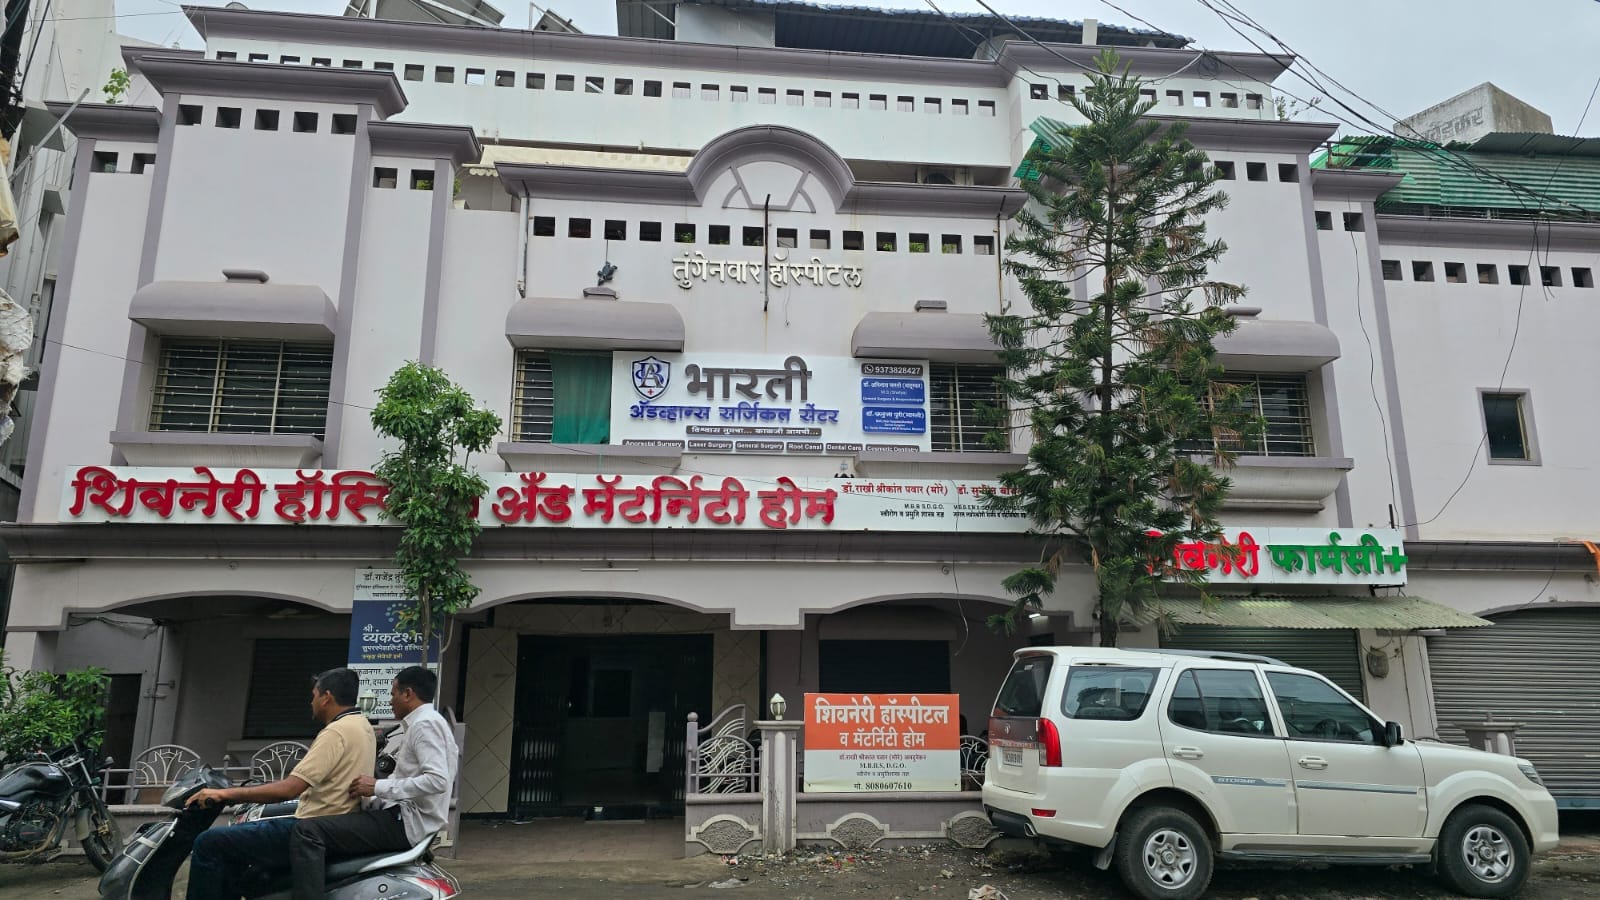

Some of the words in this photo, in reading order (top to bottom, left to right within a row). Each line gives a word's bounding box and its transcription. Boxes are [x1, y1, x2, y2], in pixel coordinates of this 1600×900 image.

[672, 250, 762, 290] तुंगेनवार
[768, 251, 864, 288] हॉस्पीटल
[685, 356, 812, 401] भारती
[876, 366, 921, 375] 9373828427
[719, 401, 791, 423] सर्जिकल
[799, 403, 839, 424] सेंटर
[69, 466, 267, 522] शिवनेरी
[274, 469, 479, 523] हॉस्पि
[581, 474, 750, 525] मॅटर्निटी
[757, 477, 838, 529] होम
[876, 482, 902, 494] श्रीकांत
[904, 486, 924, 494] पवार
[926, 483, 949, 496] (मोरे)
[956, 484, 969, 495] डॉ.
[1143, 529, 1260, 578] वनेरी
[363, 624, 373, 632] श्री
[814, 695, 876, 724] शिवनेरी
[879, 695, 950, 726] हॉस्पीटल
[839, 732, 849, 747] व
[853, 726, 899, 748] मॅटर्निटी
[902, 726, 927, 748] होम
[865, 782, 912, 790] 8080607610
